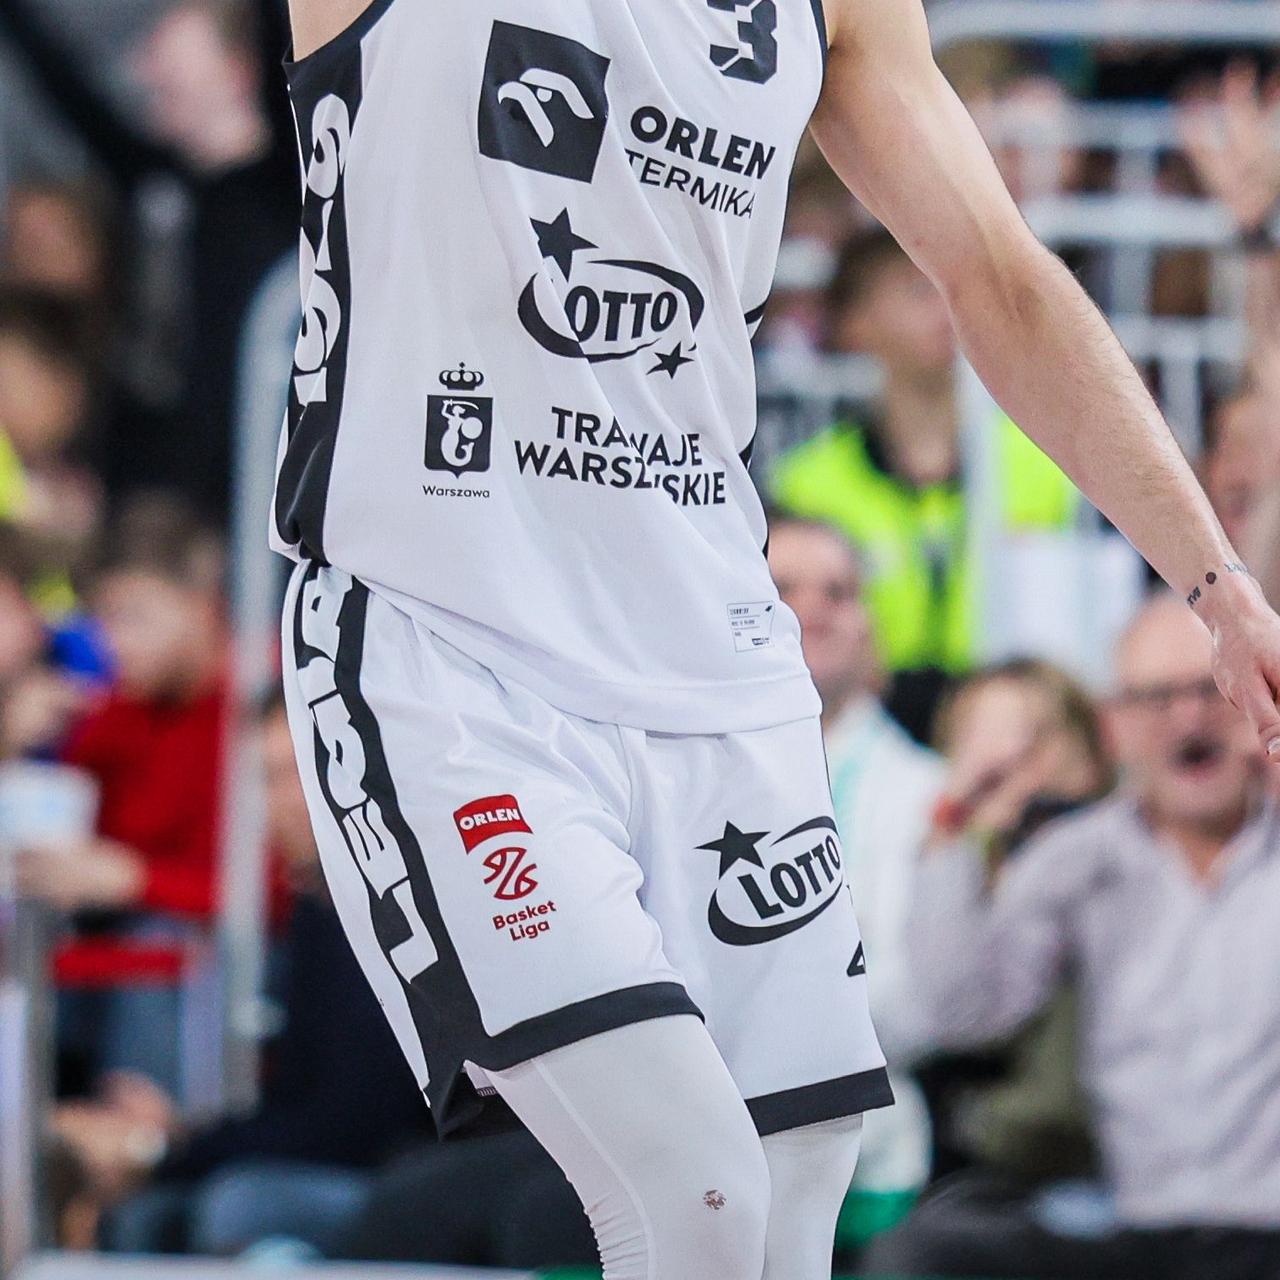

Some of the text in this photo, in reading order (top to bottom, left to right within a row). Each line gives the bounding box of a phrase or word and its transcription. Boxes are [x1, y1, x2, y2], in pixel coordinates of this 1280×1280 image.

[630, 105, 777, 180] ORLEN
[624, 148, 756, 219] TERMIKA
[564, 285, 678, 343] OTTO
[422, 484, 490, 498] Warszawa
[514, 440, 726, 506] WARSZSKIE
[459, 808, 521, 831] ORLEN
[737, 834, 841, 920] LOTTO
[492, 900, 557, 930] Basket
[509, 920, 551, 941] Liga
